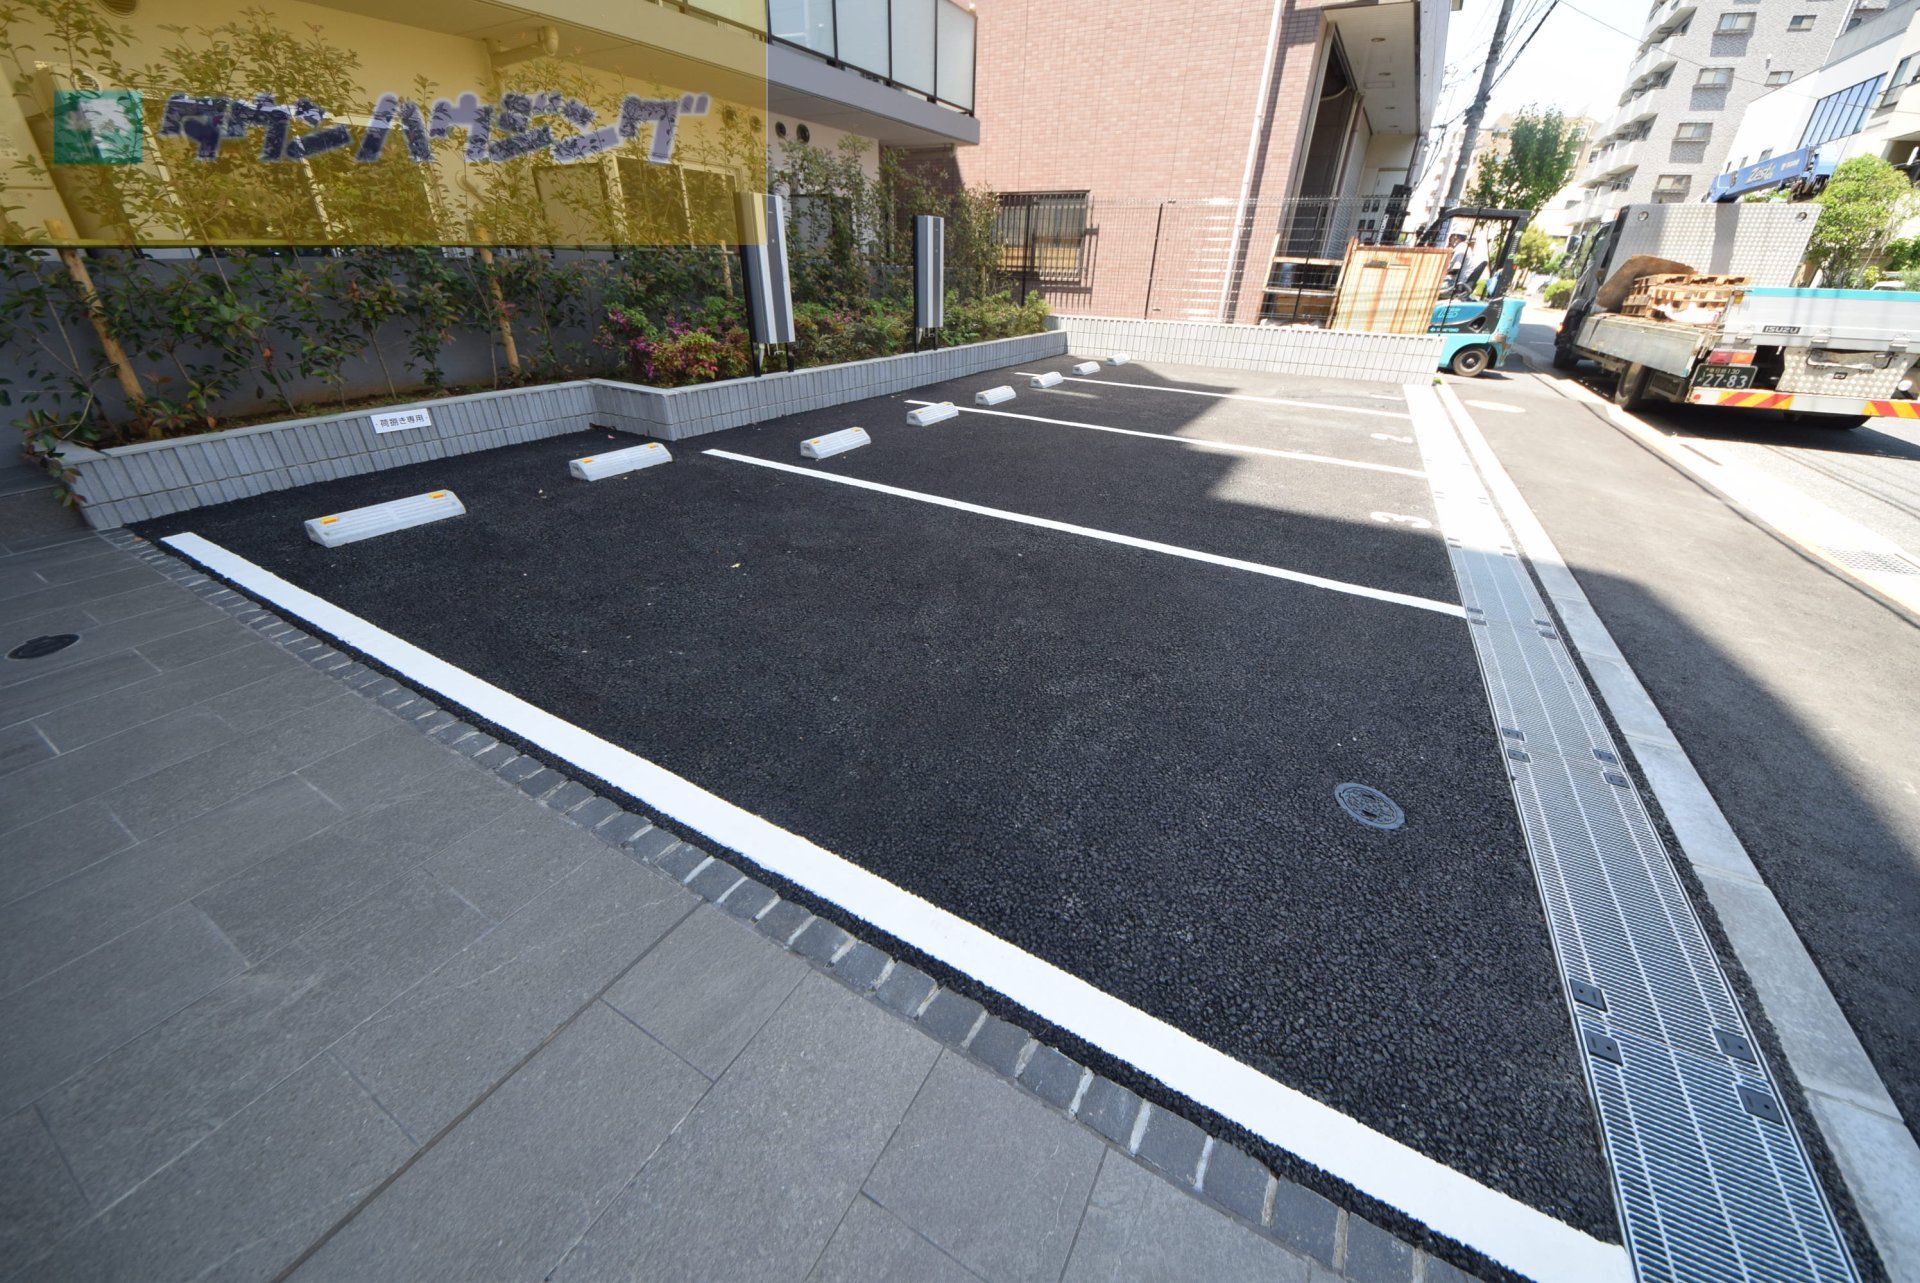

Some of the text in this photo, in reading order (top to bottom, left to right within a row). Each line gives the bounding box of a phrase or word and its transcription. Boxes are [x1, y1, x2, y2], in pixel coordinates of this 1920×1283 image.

[1764, 326, 1799, 334] ISUZU
[1702, 373, 1748, 389] 27-83
[1370, 511, 1432, 528] 3
